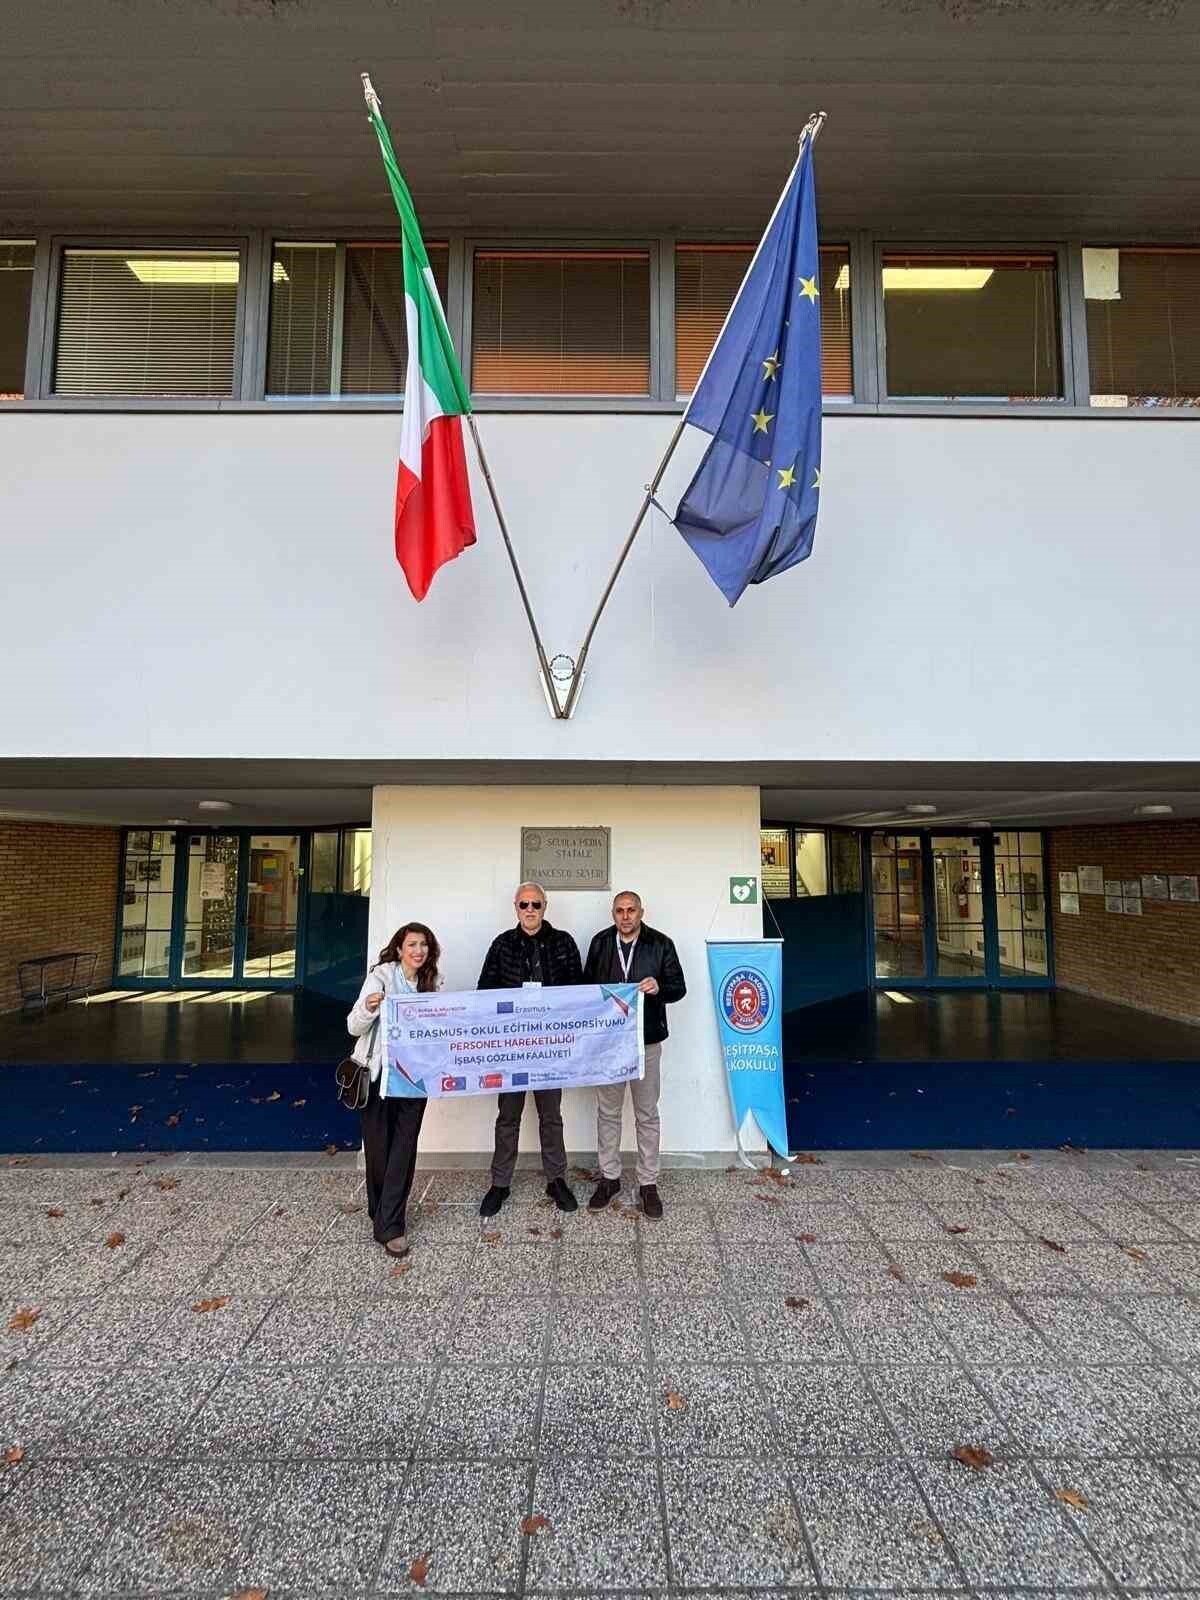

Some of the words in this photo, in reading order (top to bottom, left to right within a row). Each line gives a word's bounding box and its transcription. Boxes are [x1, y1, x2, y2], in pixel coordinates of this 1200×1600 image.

[515, 1006, 551, 1014] Erasmus+
[409, 1027, 468, 1039] ERASMUS+
[470, 1025, 500, 1036] OKUL
[502, 1020, 543, 1034] EĞİTİMİ
[545, 1017, 626, 1031] KONSORSİYUMU
[450, 1039, 502, 1052] PERSONEL
[526, 1047, 571, 1061] FAALİYETİ
